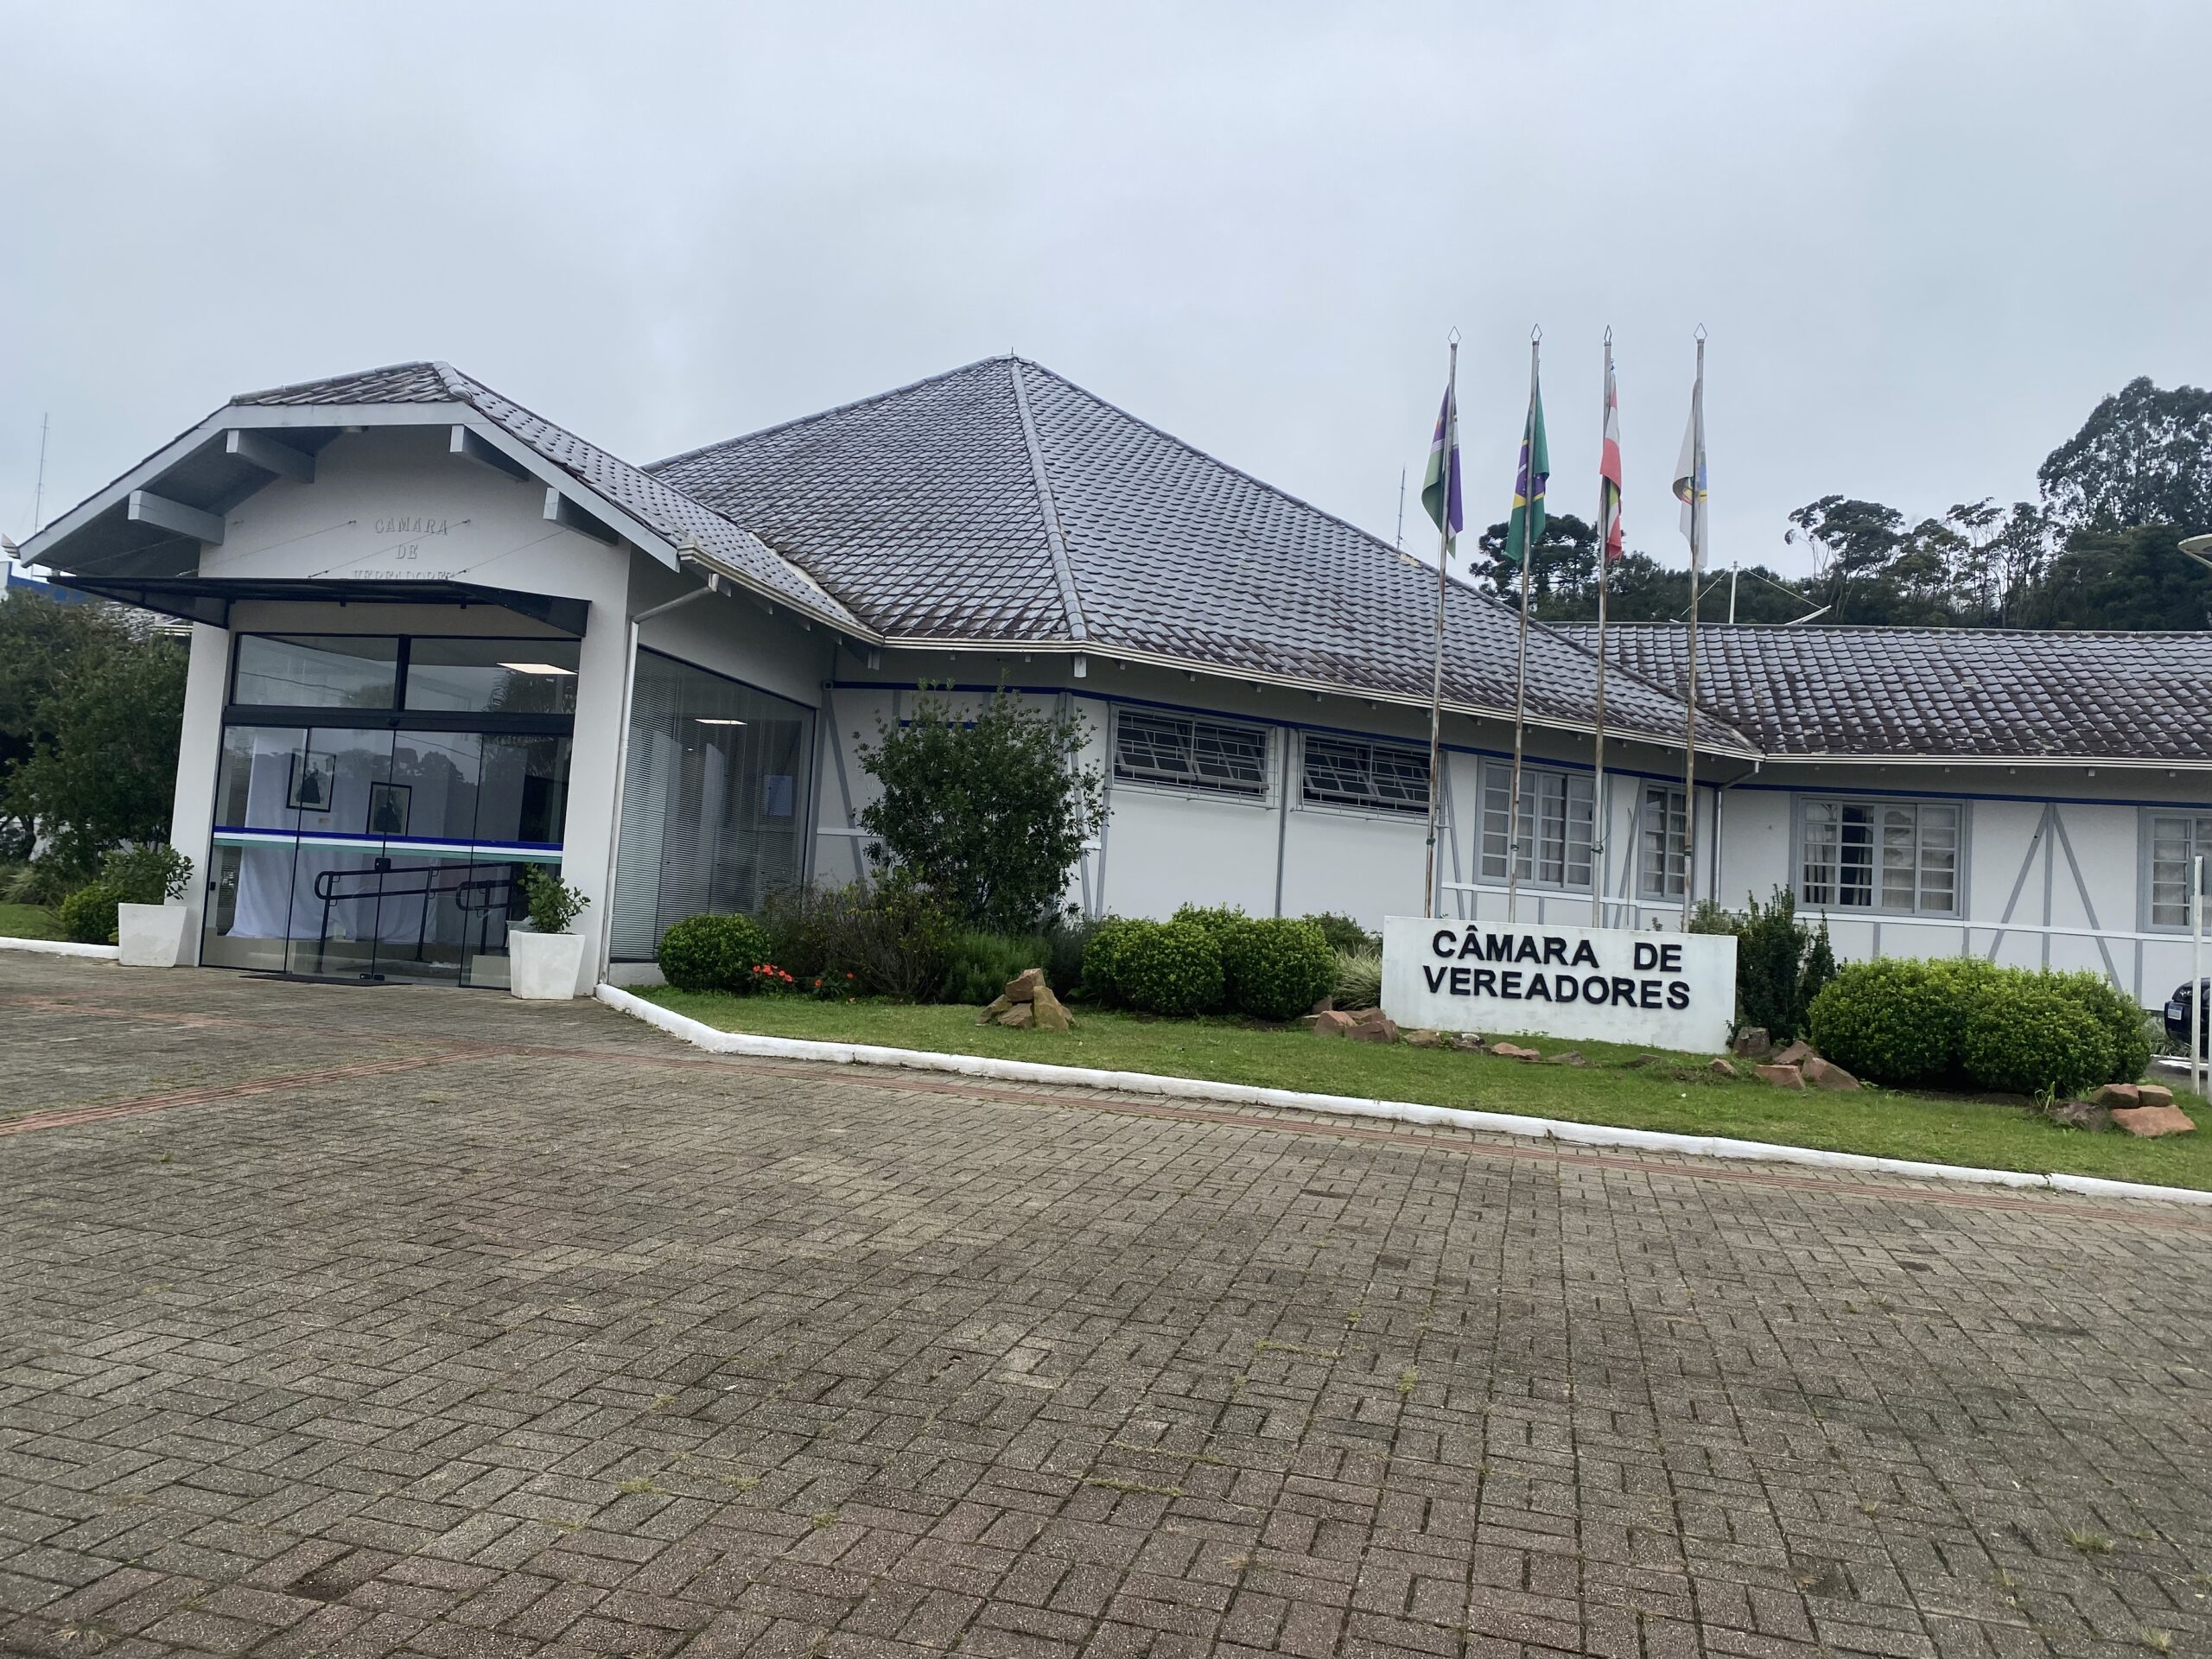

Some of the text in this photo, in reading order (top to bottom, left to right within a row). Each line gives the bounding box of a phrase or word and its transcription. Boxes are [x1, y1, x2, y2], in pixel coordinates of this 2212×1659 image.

[395, 544, 418, 560] DE
[1431, 924, 1682, 973] CÂMARA DE
[1421, 964, 1691, 1011] VEREADORES
